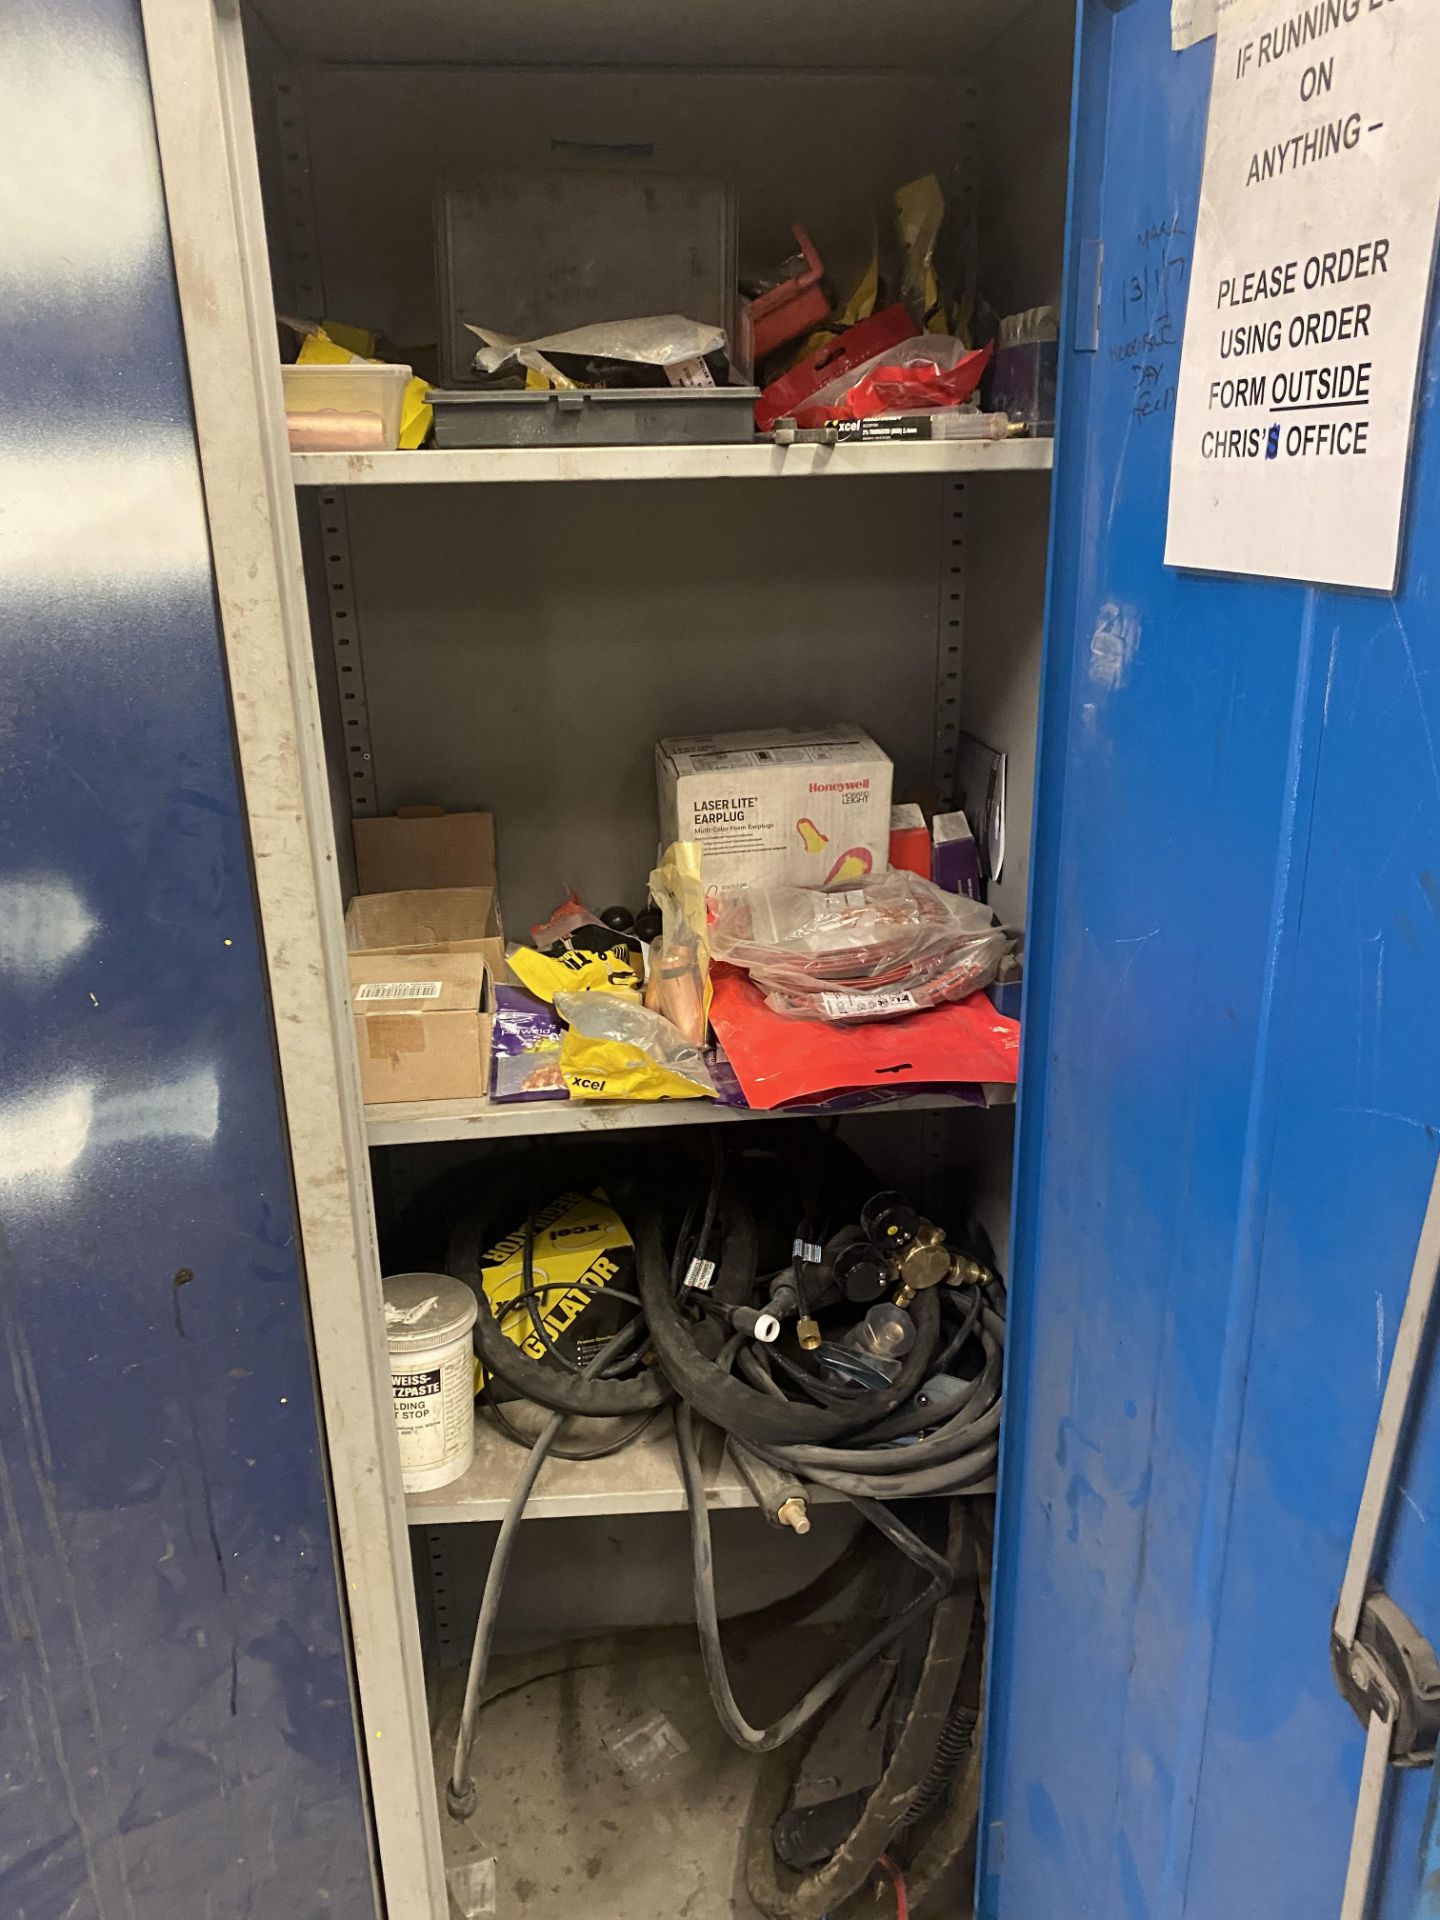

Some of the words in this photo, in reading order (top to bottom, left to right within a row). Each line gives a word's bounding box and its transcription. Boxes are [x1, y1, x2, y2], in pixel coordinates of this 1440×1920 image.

[1236, 42, 1253, 79] IF
[1257, 0, 1360, 67] RUNNING
[1300, 57, 1334, 102] ON
[1246, 113, 1361, 186] ANYTHING
[1217, 261, 1297, 309] PLEASE
[1303, 238, 1390, 289] ORDER
[1220, 320, 1282, 358] USING
[1288, 303, 1371, 348] ORDER
[1208, 376, 1266, 410] FORM
[1271, 362, 1372, 405] OUTSIDE
[1286, 421, 1369, 457] OFFICE
[809, 779, 870, 793] Honeywell
[842, 796, 869, 805] LEIGHT
[694, 799, 731, 812] LASER
[694, 811, 745, 825] EARPLUG
[572, 1077, 606, 1091] xcel
[402, 1410, 430, 1419] STOP
